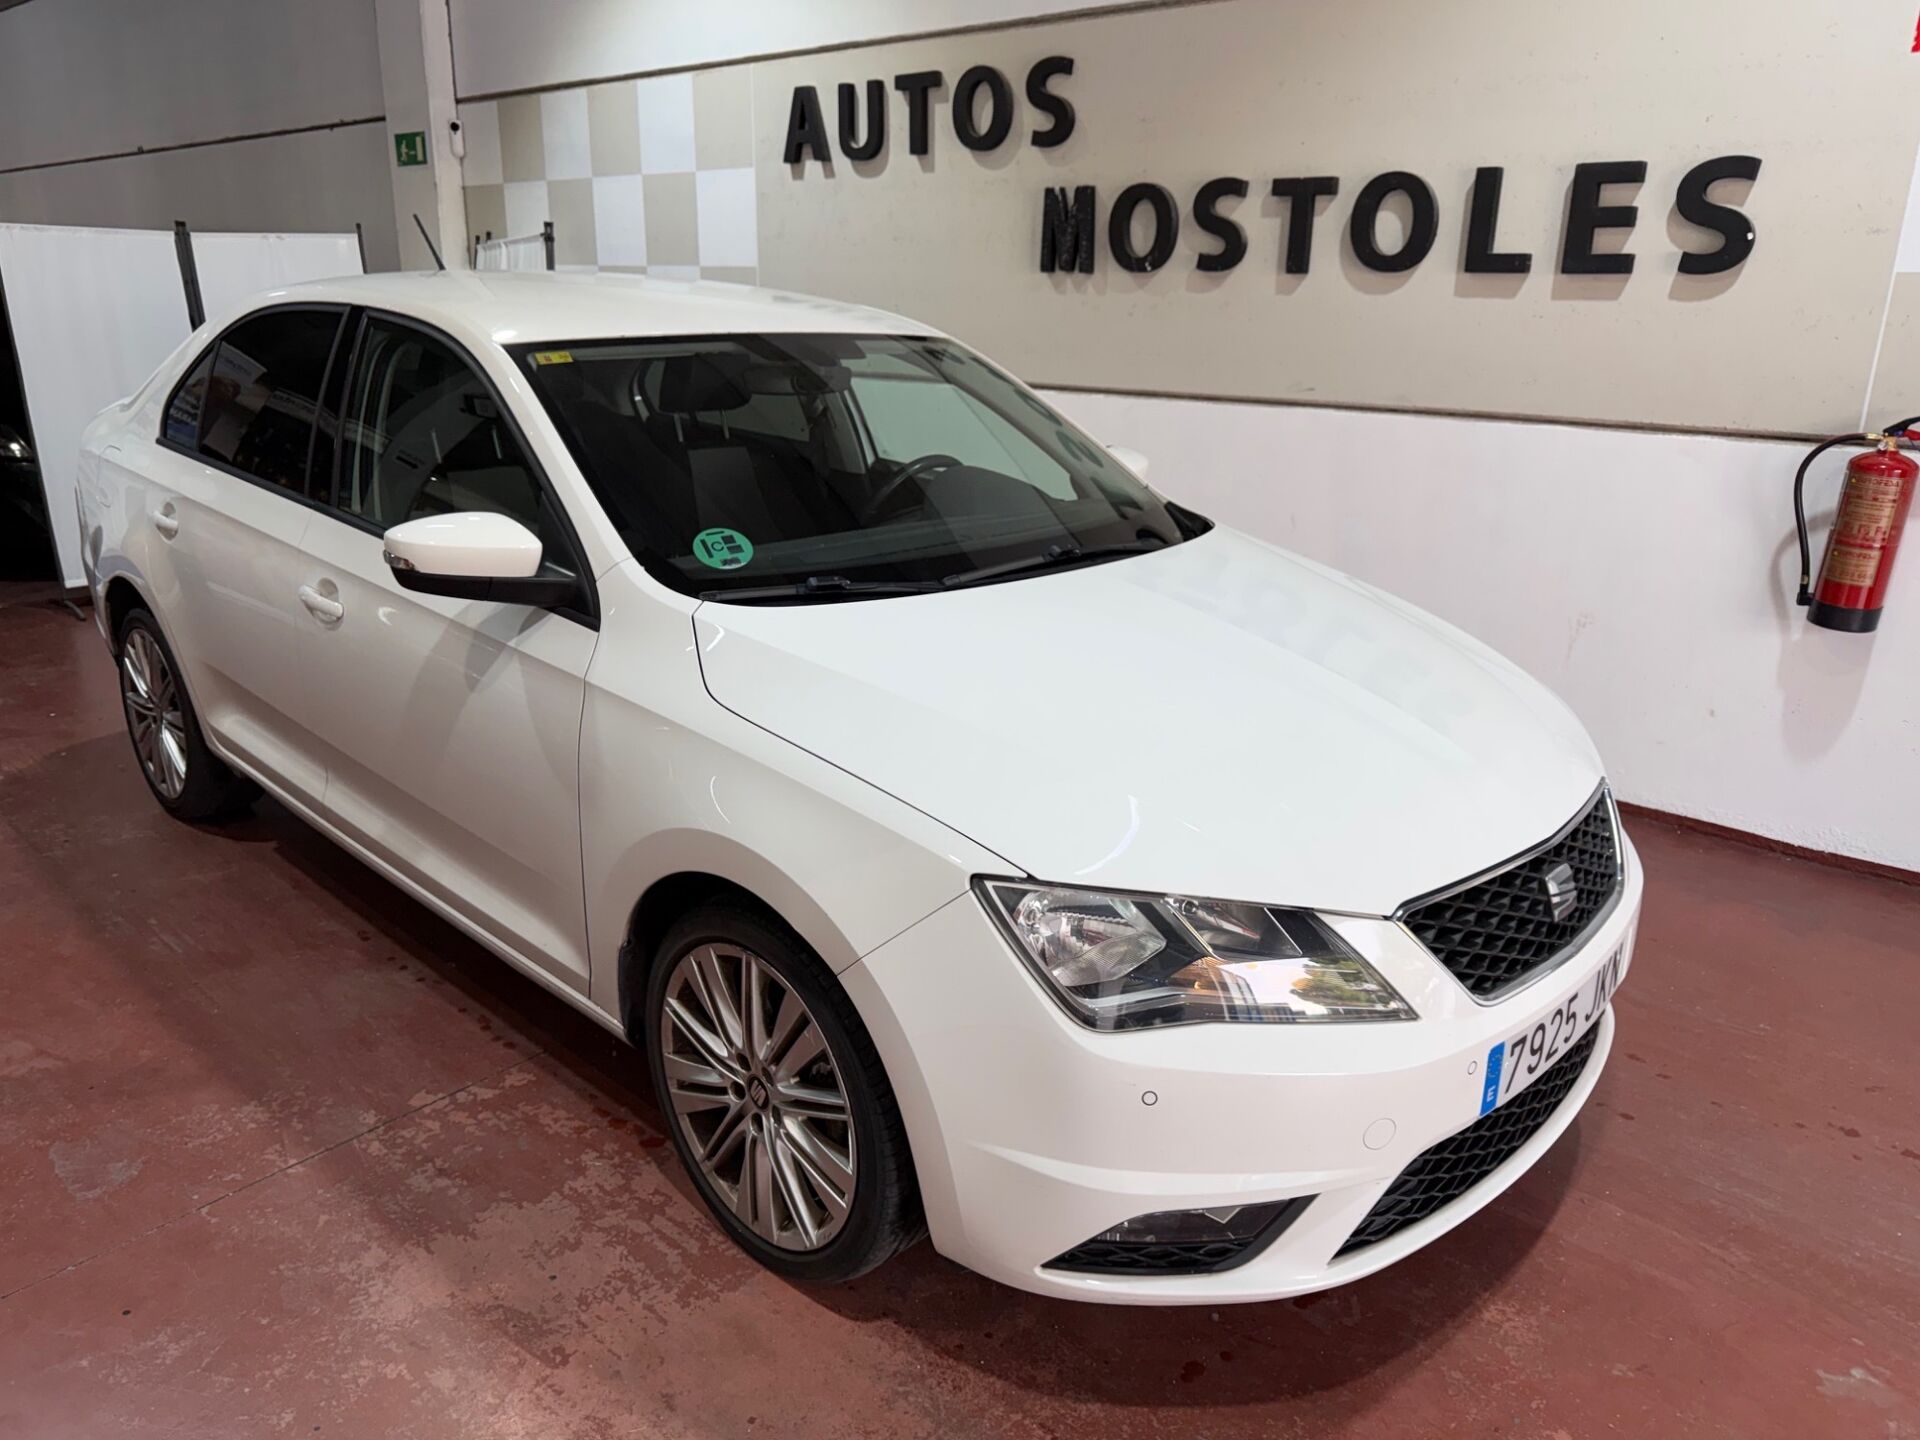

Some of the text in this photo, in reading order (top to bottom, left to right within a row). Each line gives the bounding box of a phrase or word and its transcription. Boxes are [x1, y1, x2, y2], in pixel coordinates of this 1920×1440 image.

[783, 55, 1077, 165] AUTOS
[1039, 154, 1763, 276] MOSTOLES
[1504, 991, 1579, 1094] 7925
[1584, 941, 1624, 1022] JKN
